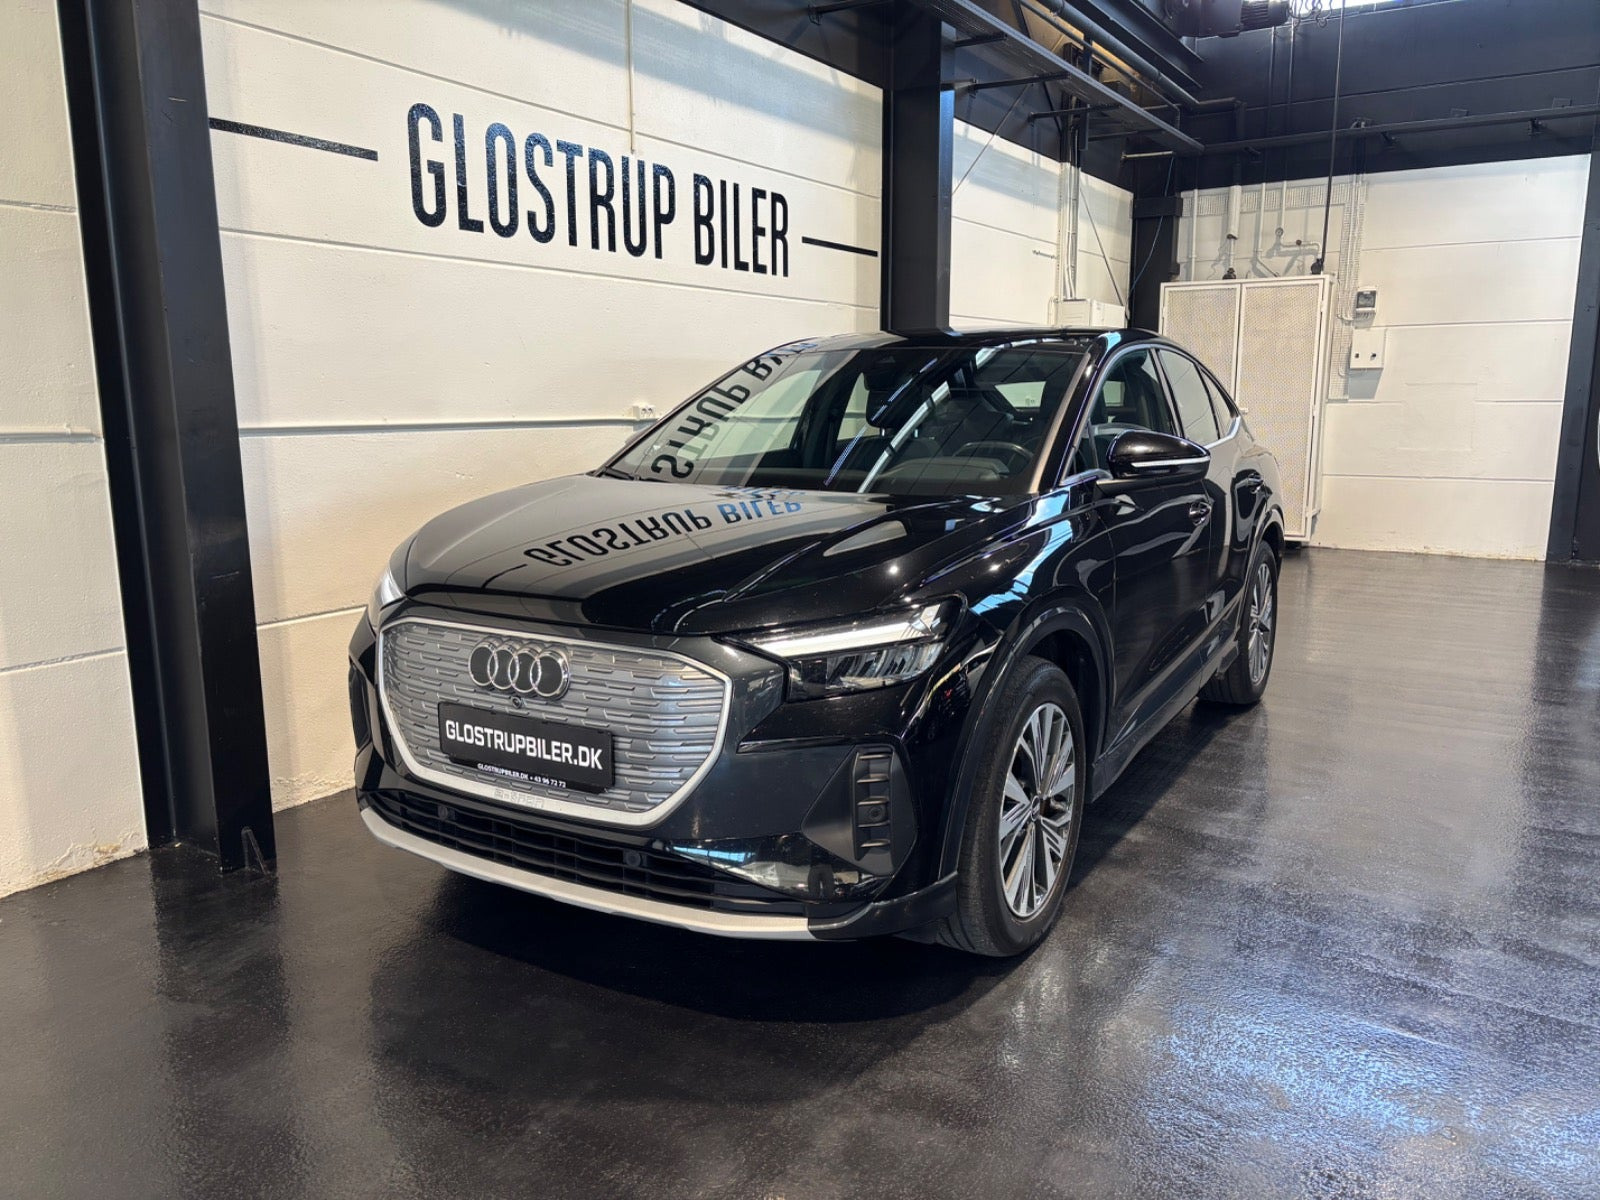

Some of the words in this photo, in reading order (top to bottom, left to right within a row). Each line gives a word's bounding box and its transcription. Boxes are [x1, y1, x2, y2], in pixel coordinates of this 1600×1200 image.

[407, 103, 676, 260] GLOSTRUP
[693, 173, 789, 277] BILER
[445, 720, 603, 770] GLOSTRUPBILER.DK
[477, 763, 529, 780] GLOSTRUPBILER.DK
